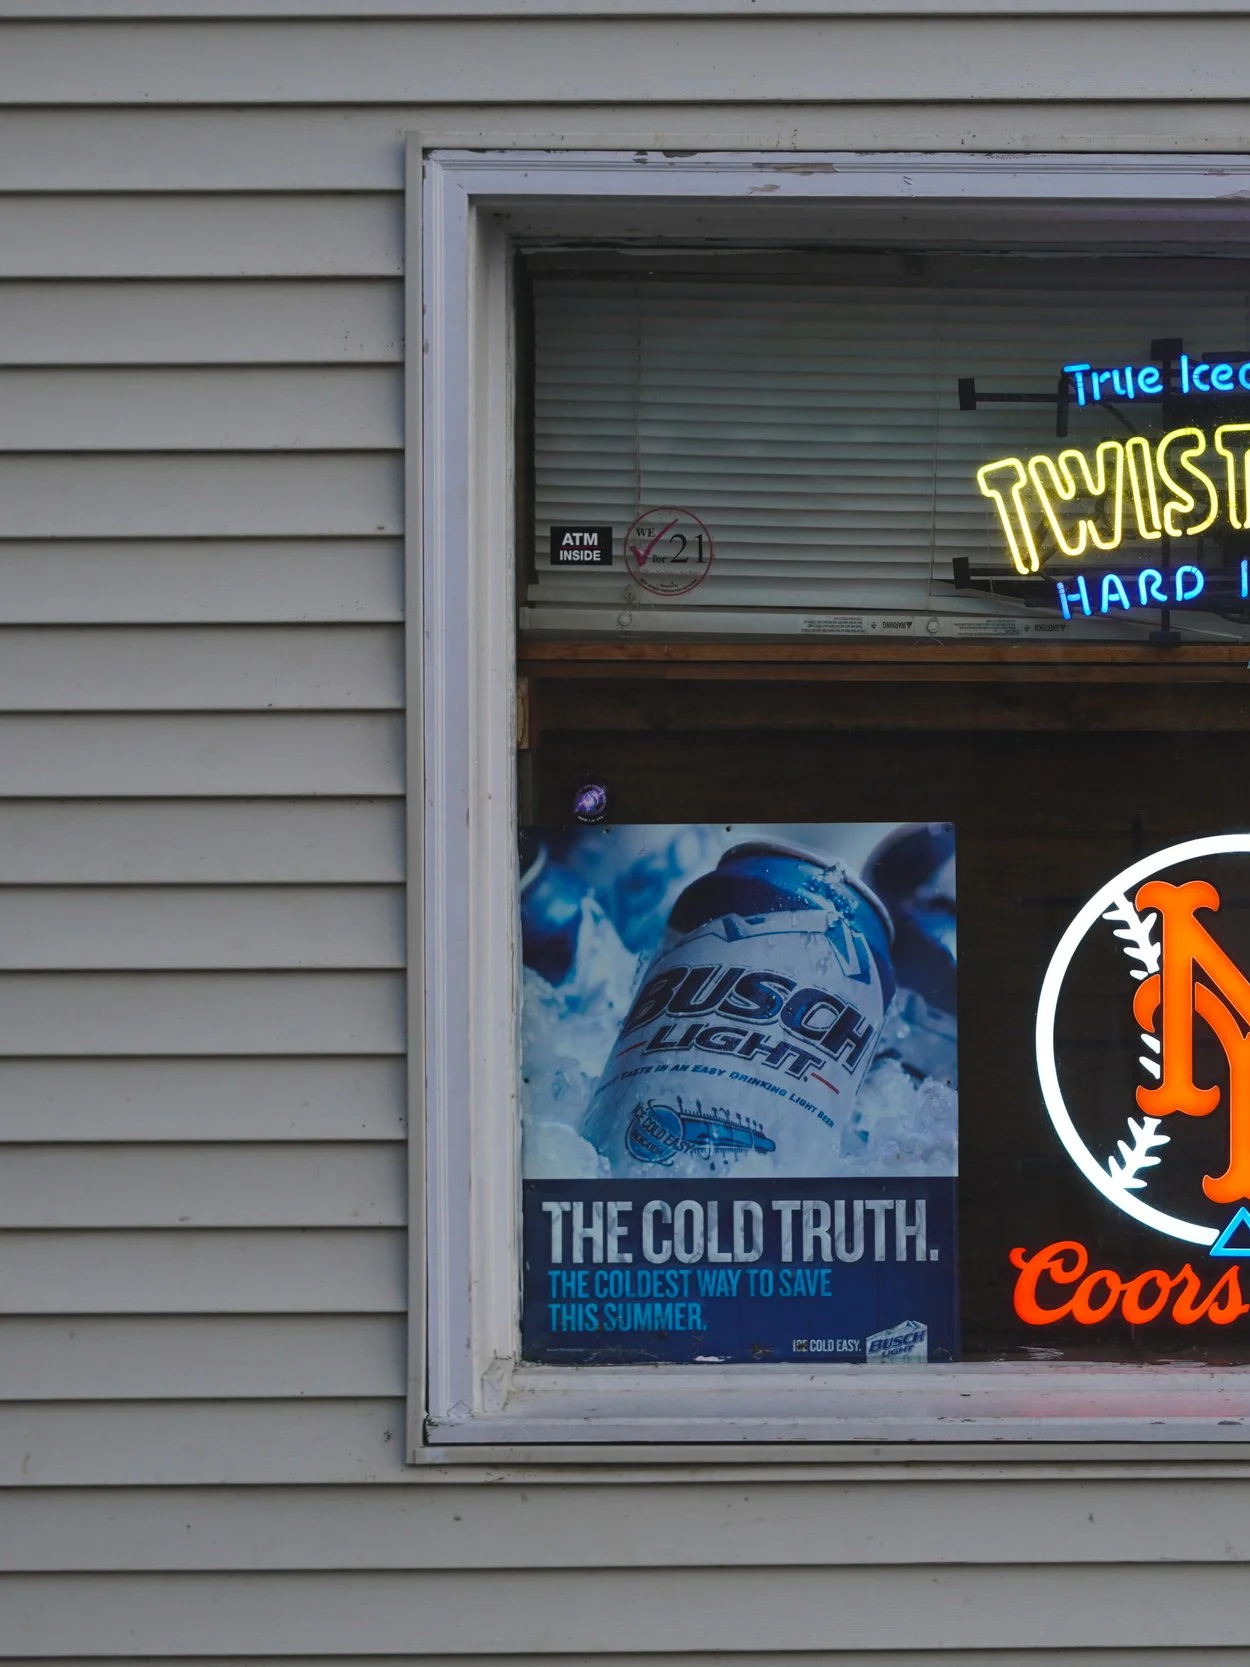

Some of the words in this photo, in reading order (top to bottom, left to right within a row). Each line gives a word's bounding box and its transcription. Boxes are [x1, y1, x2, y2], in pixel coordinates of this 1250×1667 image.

[1064, 362, 1164, 406] True
[560, 550, 601, 561] INSIDE
[562, 532, 598, 546] ATM
[636, 528, 656, 538] WE
[652, 554, 667, 564] for
[669, 534, 706, 564] 21
[1056, 564, 1205, 620] HARD
[623, 964, 875, 1074] BUSCH
[643, 1022, 826, 1081] LIGHT
[690, 1064, 726, 1077] EASY
[728, 1072, 788, 1097] DRINKING
[788, 1092, 818, 1115] LIGHT
[817, 1110, 834, 1129] BEER
[541, 1200, 634, 1264] THE
[641, 1200, 764, 1264] COLD
[771, 1199, 940, 1263] TRUTH.
[547, 1269, 589, 1298] THE
[594, 1268, 691, 1299] COLDEST
[695, 1268, 740, 1297] WAY
[745, 1268, 774, 1297] TO
[779, 1268, 832, 1297] SAVE
[1009, 1240, 1250, 1326] Coors
[547, 1302, 598, 1332] THIS
[604, 1302, 708, 1332] SUMMER.
[809, 1339, 834, 1352] COLD
[836, 1339, 862, 1352] EASY.
[868, 1330, 926, 1354] BUSCH
[881, 1344, 916, 1358] LIGHT
